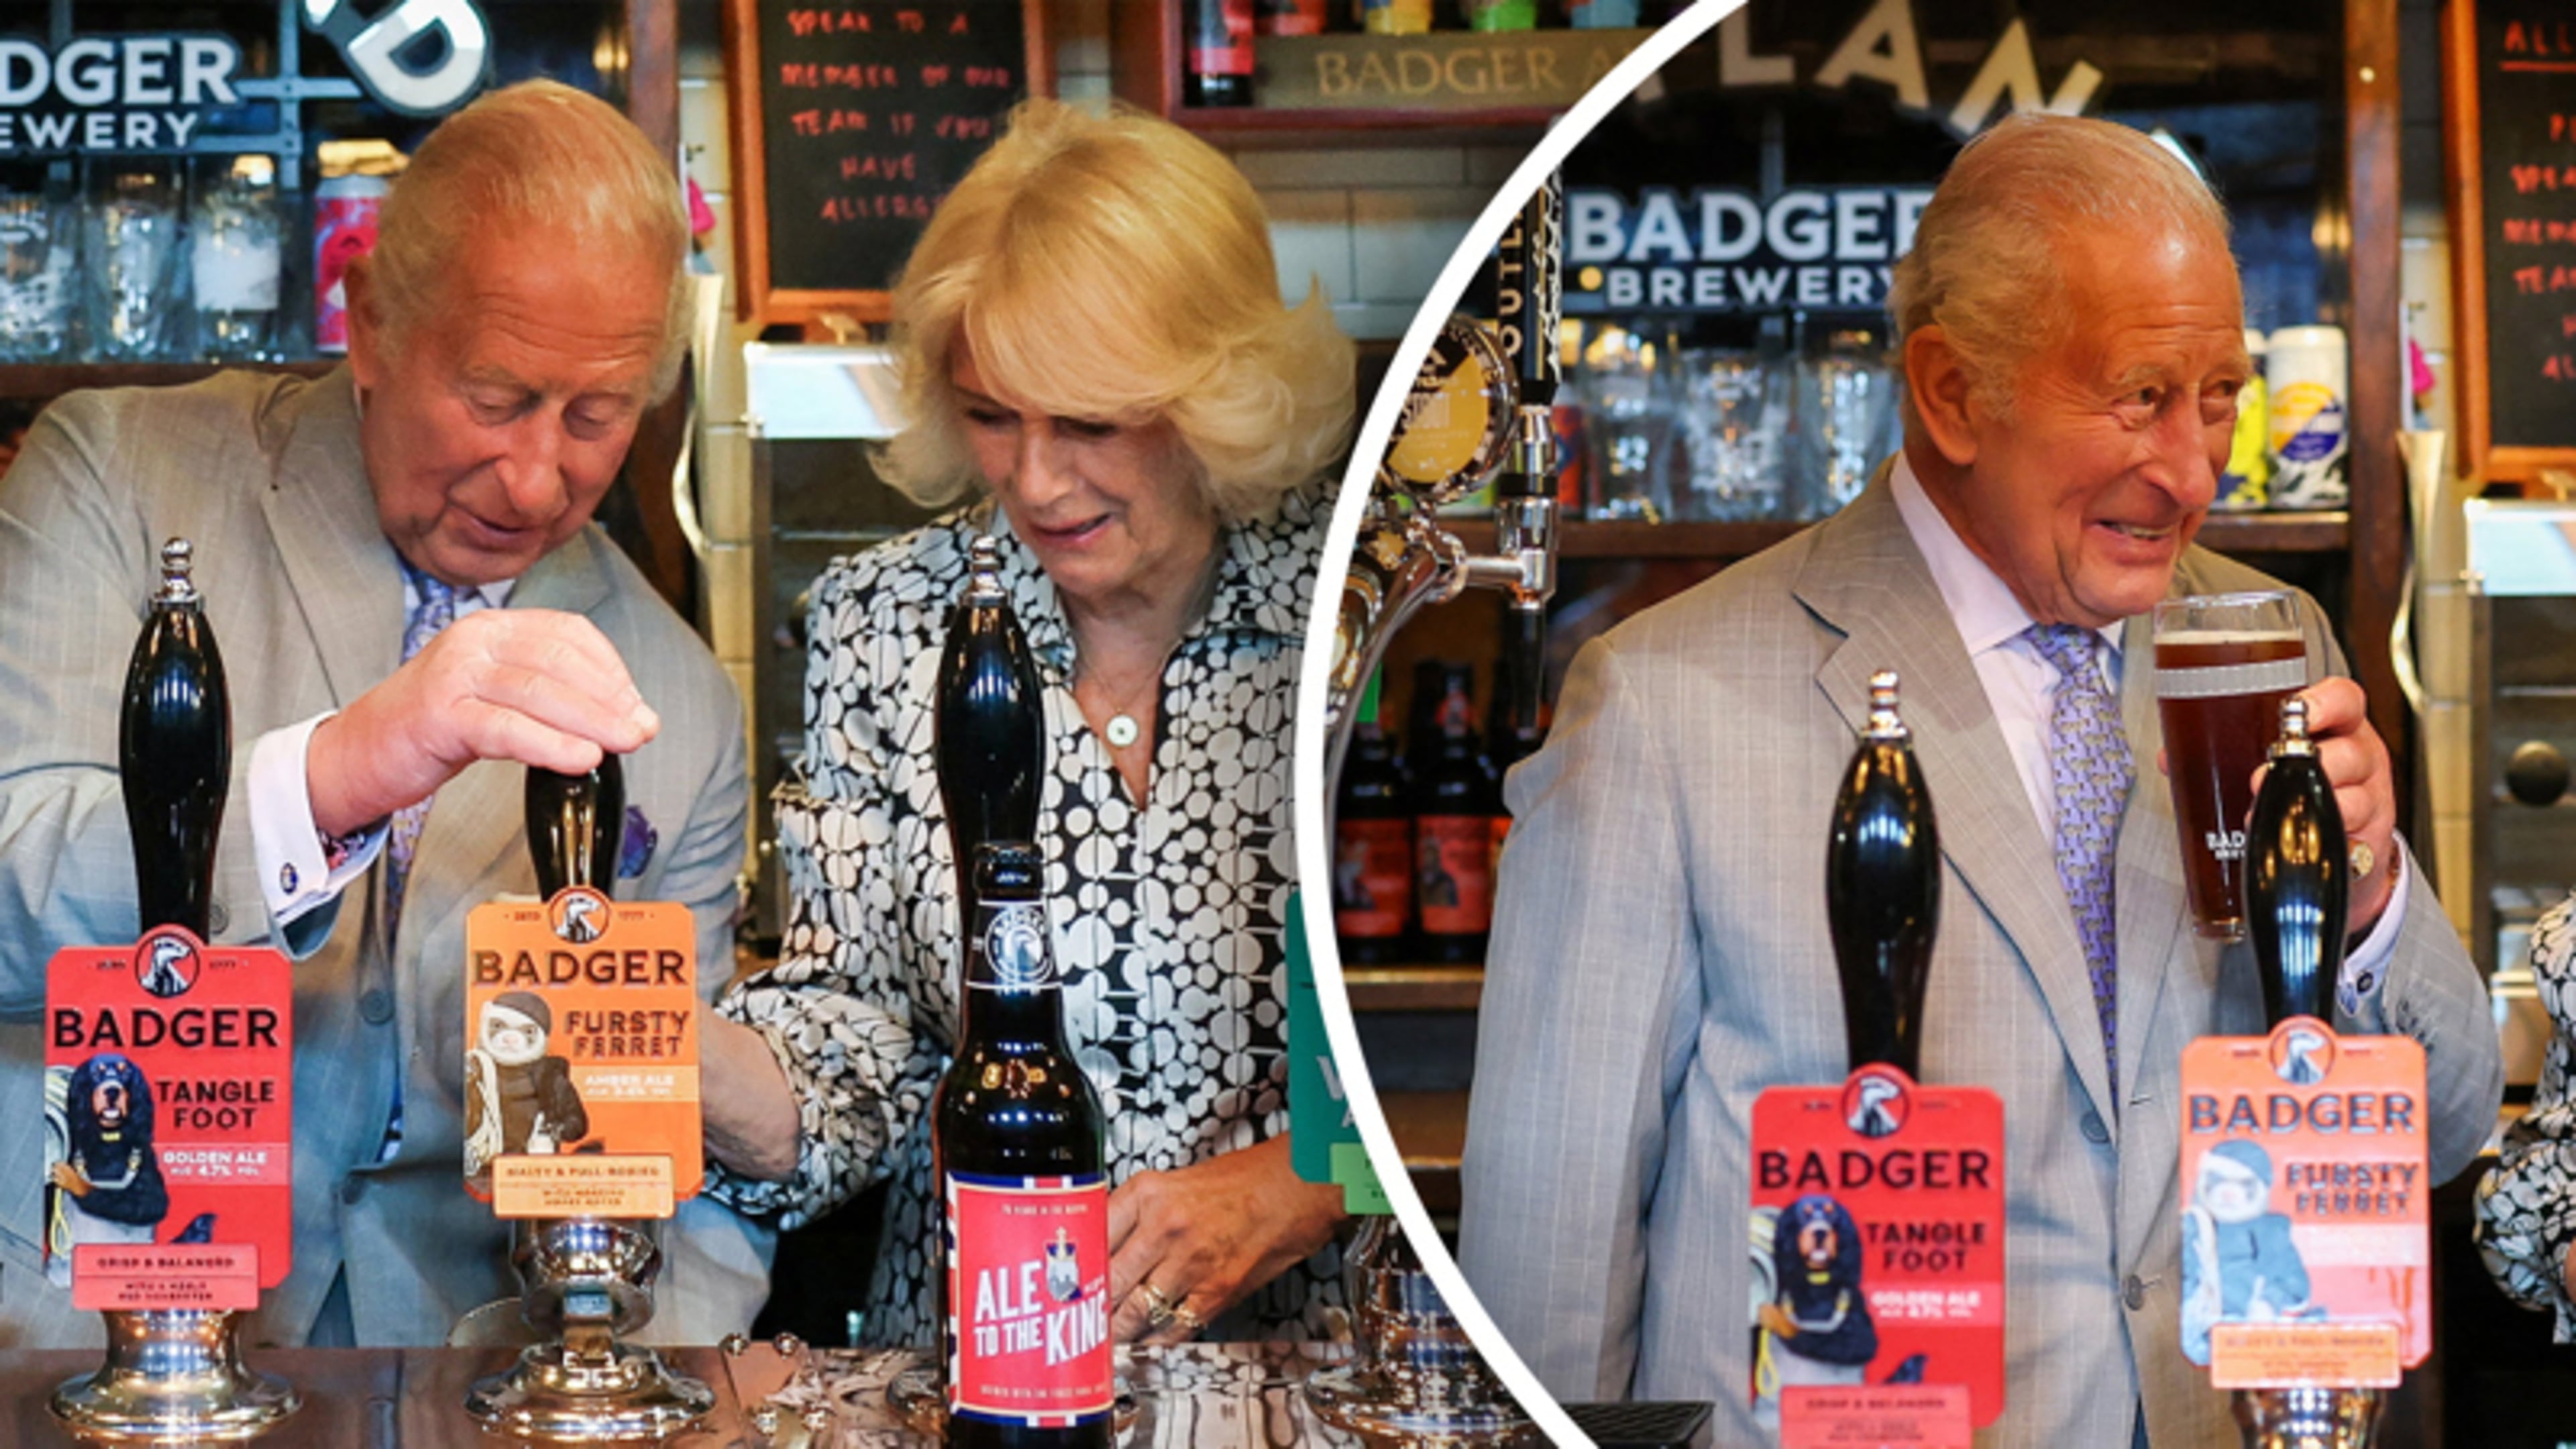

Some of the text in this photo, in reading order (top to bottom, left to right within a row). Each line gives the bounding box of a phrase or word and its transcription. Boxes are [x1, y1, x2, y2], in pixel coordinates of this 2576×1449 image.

[948, 13, 969, 34] A
[780, 64, 898, 88] MEMBER
[1316, 45, 1564, 97] BADGER
[791, 109, 867, 136] TEAM
[841, 153, 917, 181] HAVE
[1499, 211, 1524, 358] OUTL
[474, 949, 688, 985] BADGER
[54, 1008, 278, 1048] BADGER
[566, 1010, 690, 1035] FURSTY
[574, 1036, 682, 1059] FERRET
[155, 1080, 275, 1104] TANGLE
[174, 1107, 257, 1129] FOOT
[2188, 1093, 2416, 1134] BADGER
[162, 1150, 267, 1165] GOLDEN ALE
[1758, 1150, 1990, 1190] BADGER
[2286, 1163, 2418, 1189] FURSTY
[2296, 1191, 2410, 1216] FERRET
[1866, 1222, 1986, 1245] TANGLE
[1884, 1250, 1968, 1271] FOOT
[973, 1260, 1044, 1323] ALE
[973, 1288, 1108, 1367] TO THE KING
